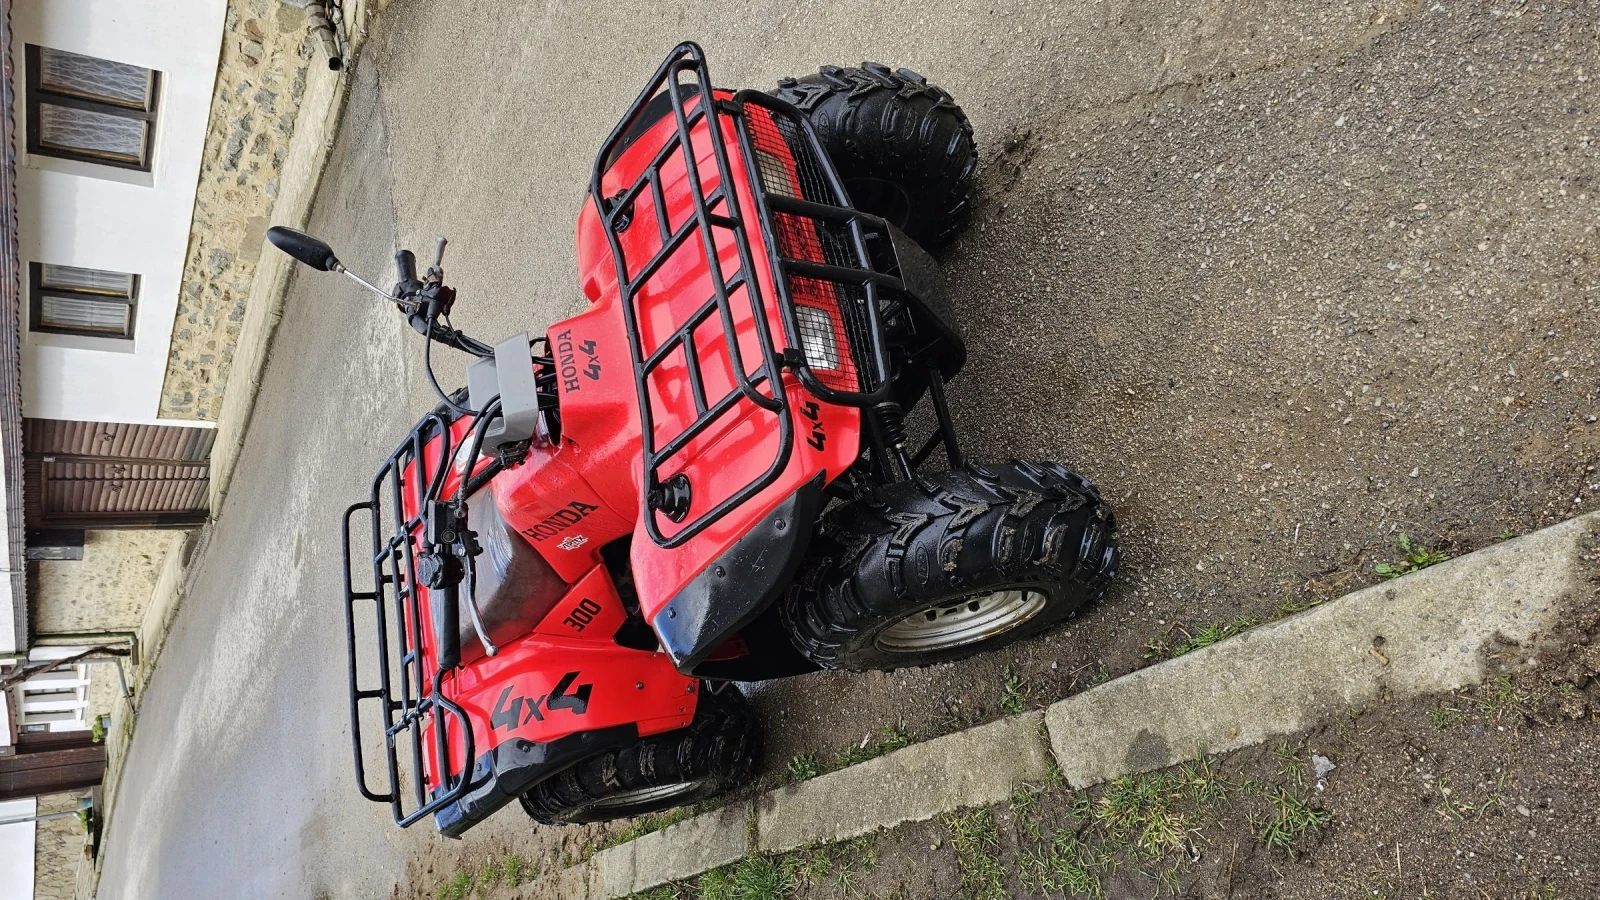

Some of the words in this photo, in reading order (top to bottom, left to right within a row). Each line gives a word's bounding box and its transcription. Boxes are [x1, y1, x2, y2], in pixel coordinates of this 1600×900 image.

[557, 329, 580, 393] HONDA
[578, 340, 601, 380] 4x4
[800, 401, 826, 452] 4x4
[522, 501, 599, 542] HONDA
[562, 598, 602, 632] 300
[490, 671, 593, 732] 4x4
